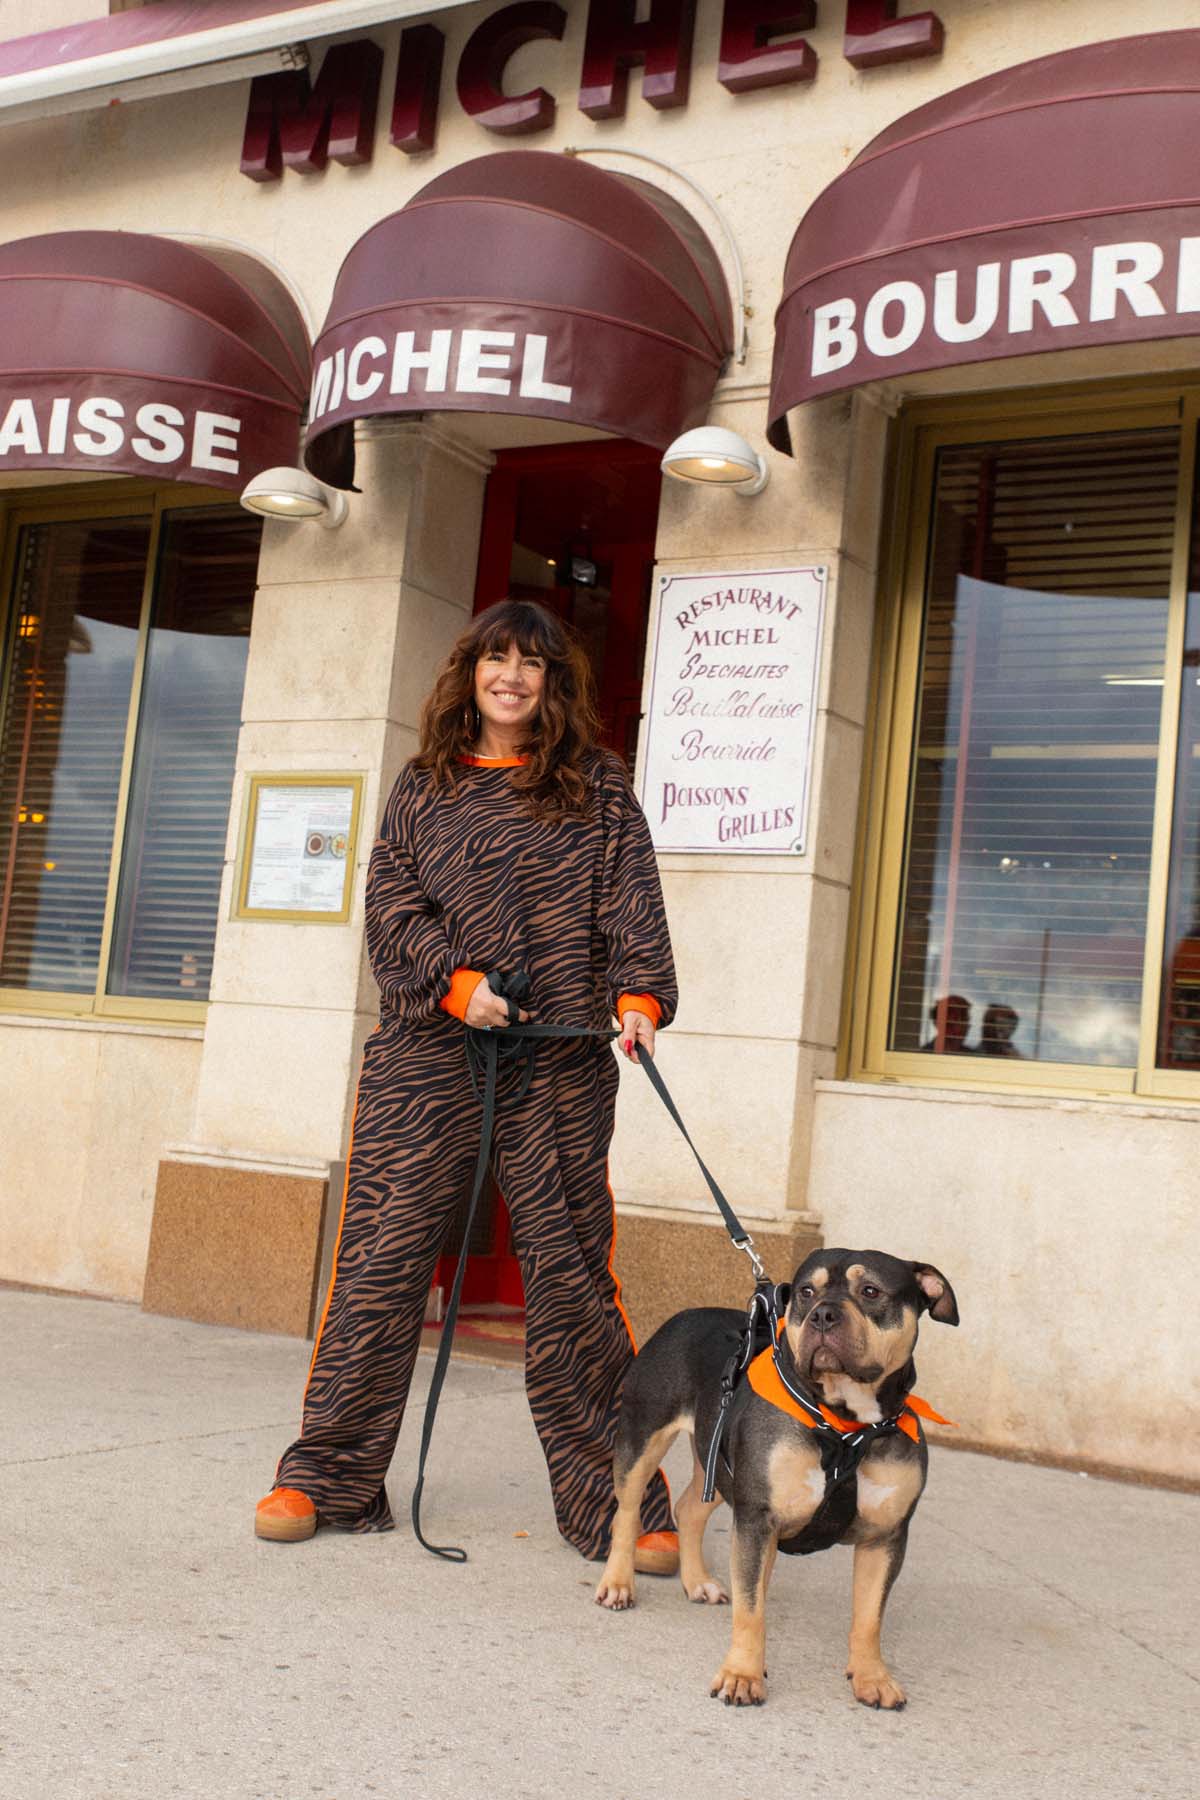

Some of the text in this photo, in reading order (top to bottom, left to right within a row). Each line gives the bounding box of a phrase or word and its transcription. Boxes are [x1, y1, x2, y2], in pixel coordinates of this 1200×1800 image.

[240, 0, 944, 183] MICHEL
[308, 329, 573, 425] MICHEL
[0, 396, 242, 475] AISSE
[675, 587, 803, 630] RESTAURANT
[684, 627, 781, 655] MICHEL
[661, 782, 750, 825] POISSONS
[718, 804, 796, 843] GRILLES
